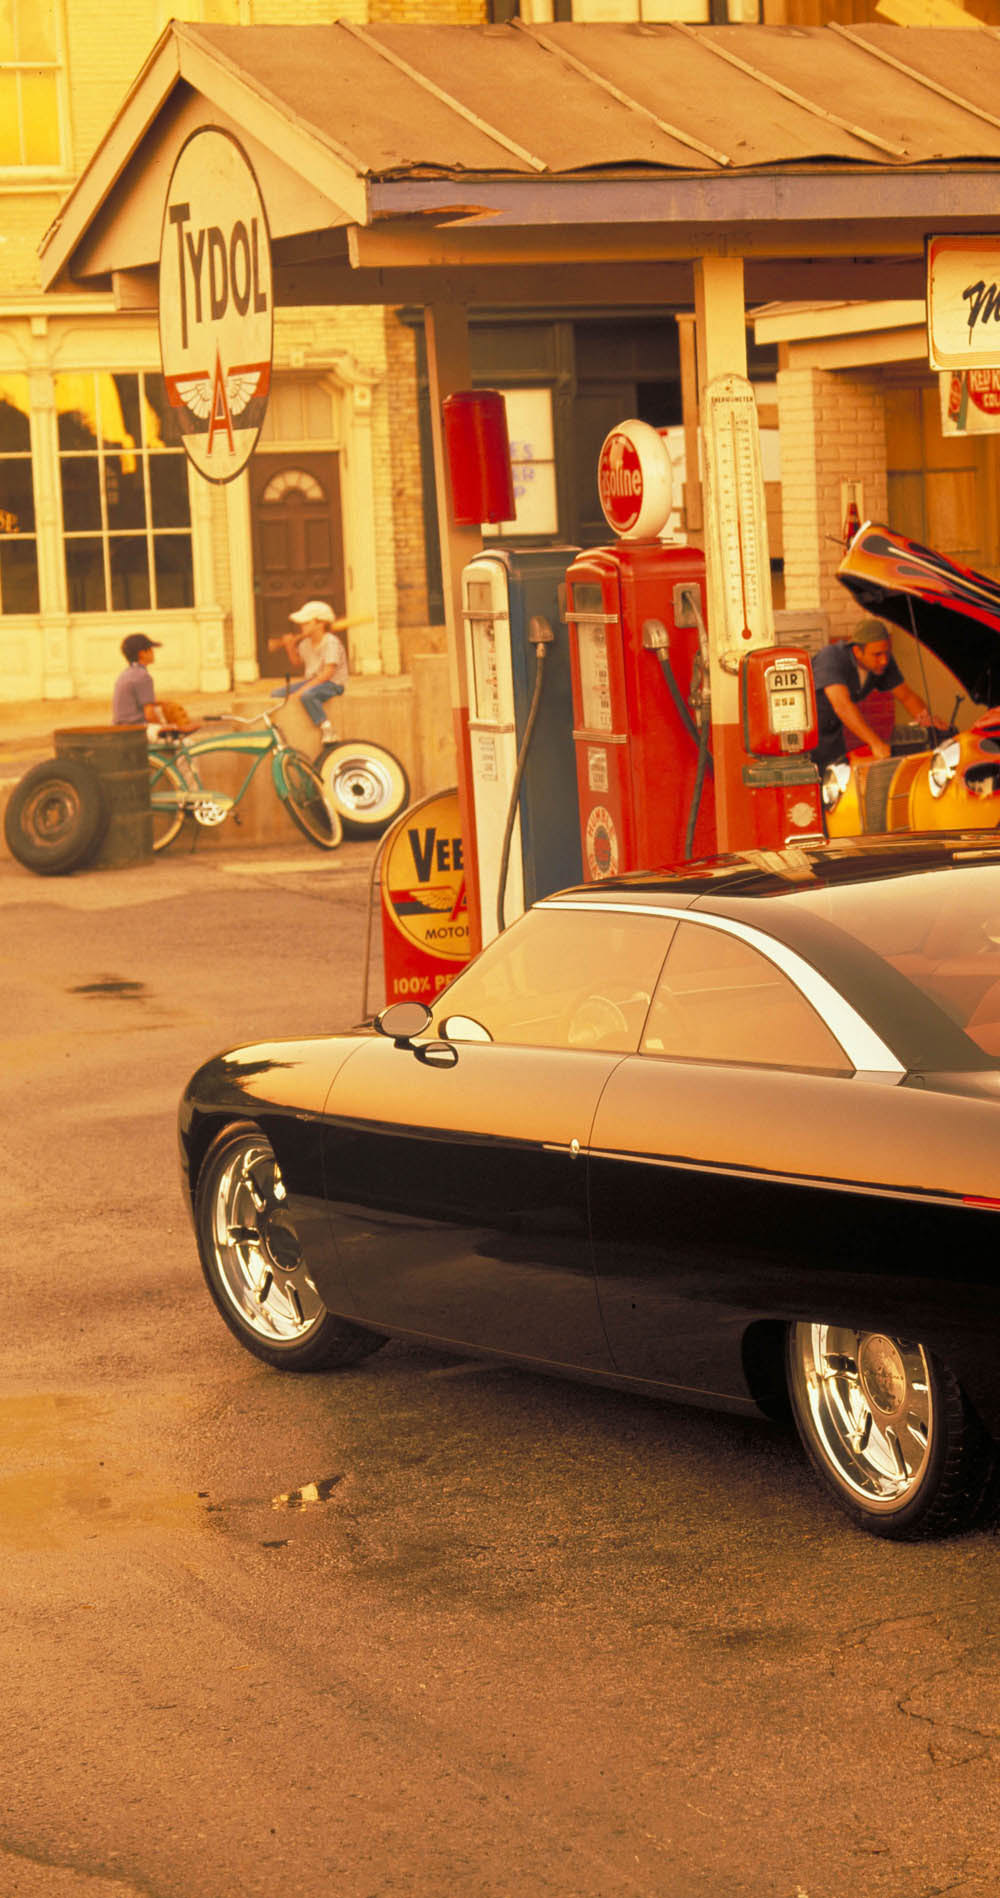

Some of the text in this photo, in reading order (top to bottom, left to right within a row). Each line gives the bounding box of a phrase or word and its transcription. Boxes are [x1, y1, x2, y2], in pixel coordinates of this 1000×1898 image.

[169, 202, 267, 349] TYDOL
[774, 674, 798, 686] AIR
[408, 827, 464, 883] VEE
[425, 926, 469, 940] MOTO
[393, 972, 458, 994] 100% PE
